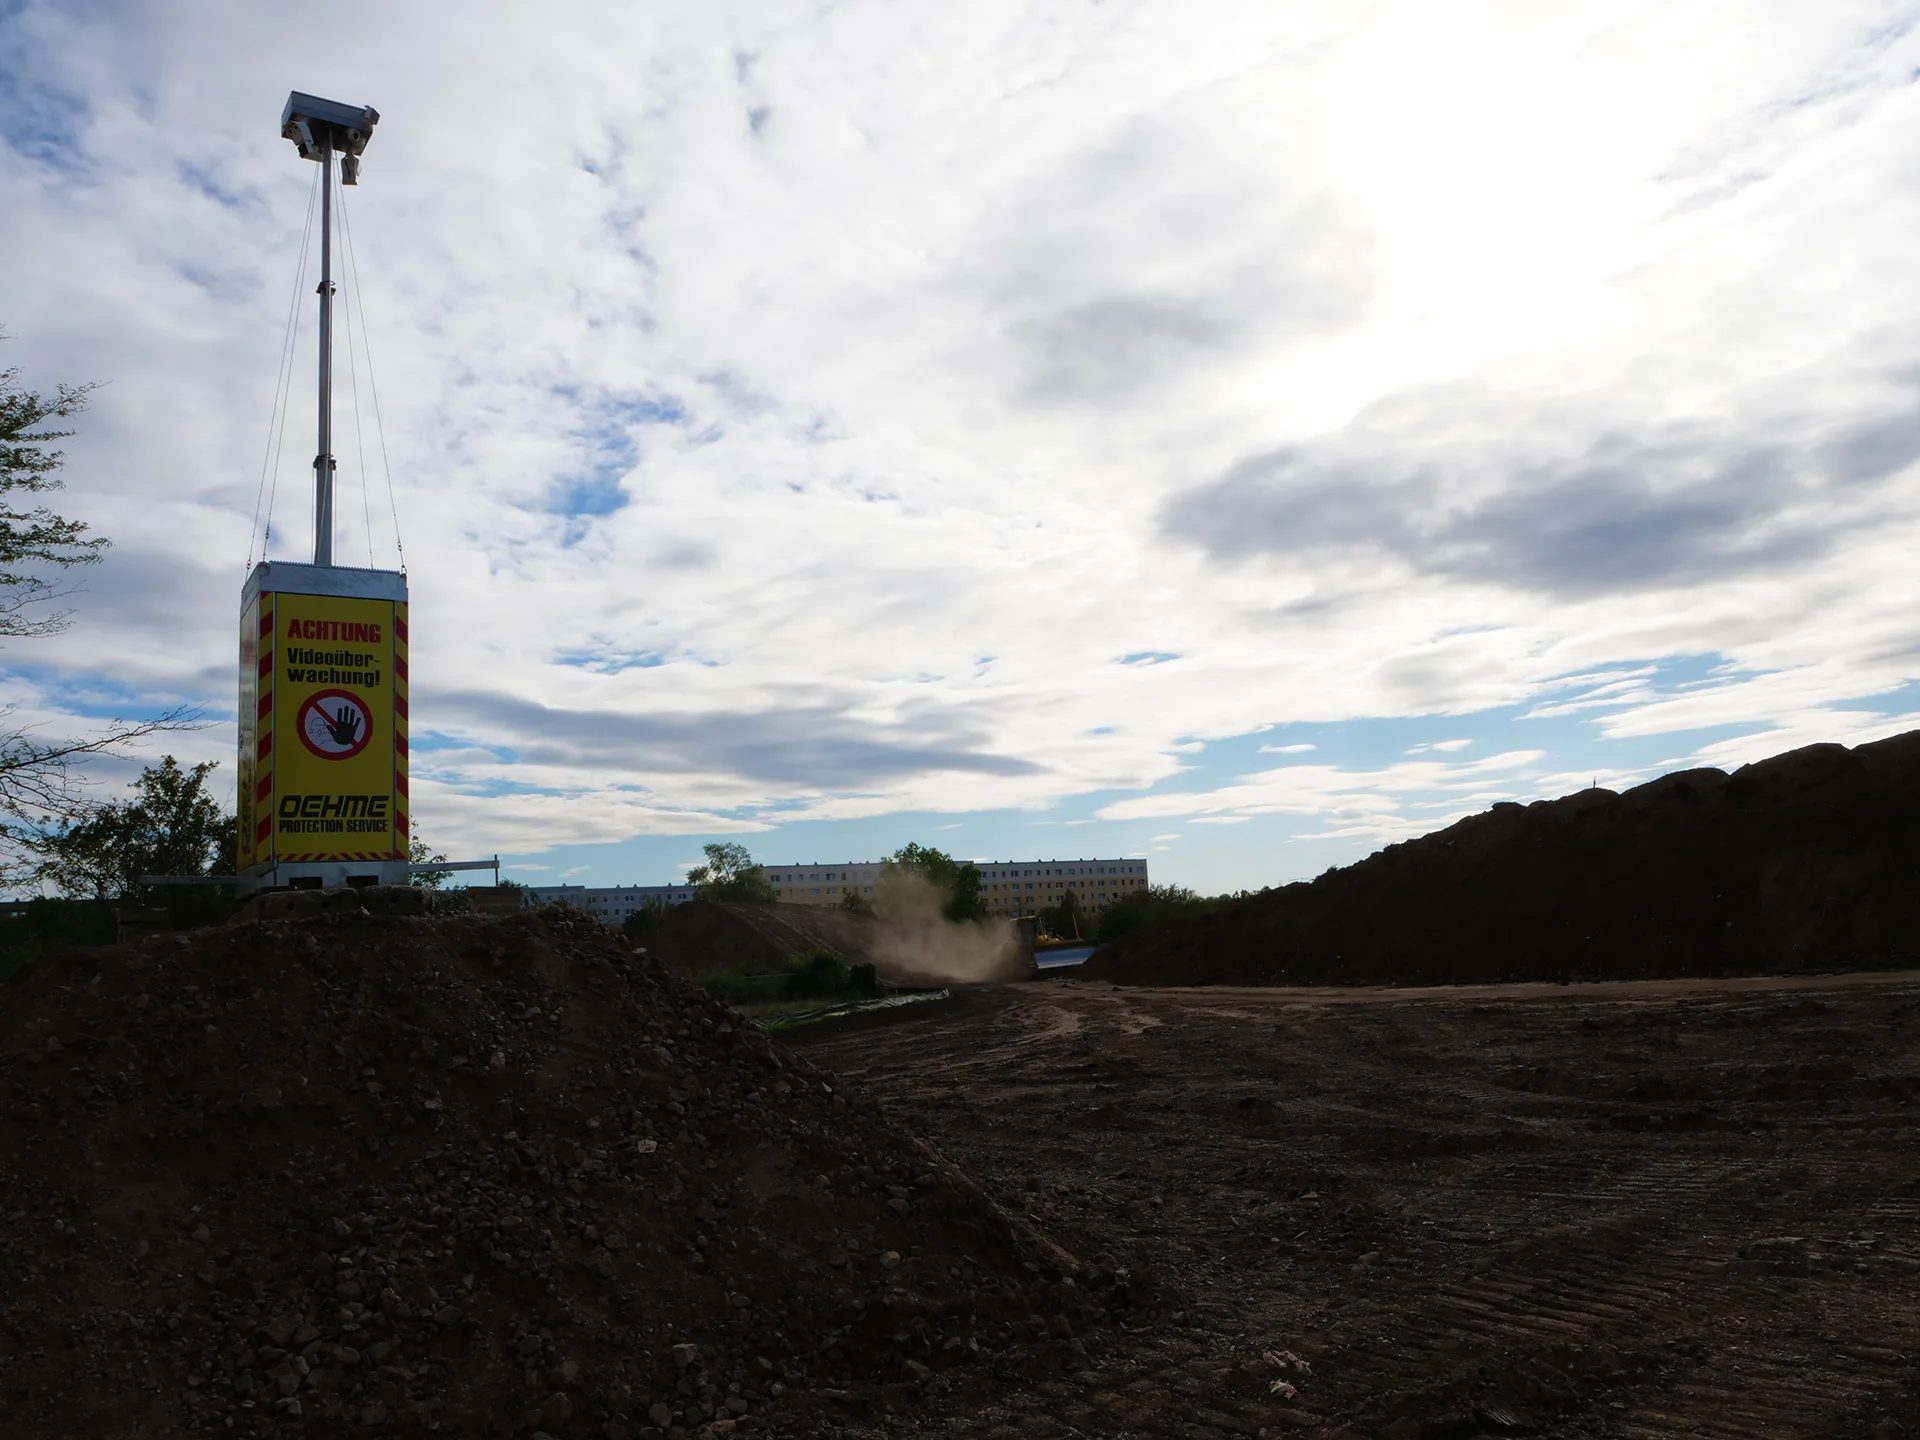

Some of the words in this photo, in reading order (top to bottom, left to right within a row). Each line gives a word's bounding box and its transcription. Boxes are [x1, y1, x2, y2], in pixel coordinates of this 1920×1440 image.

[287, 618, 381, 643] ACHTUNG
[287, 647, 381, 667] Videoüber-
[287, 668, 380, 687] wachung!
[278, 795, 390, 818] OEHME
[279, 820, 343, 833] PROTECTION
[346, 820, 388, 833] SERVICE
